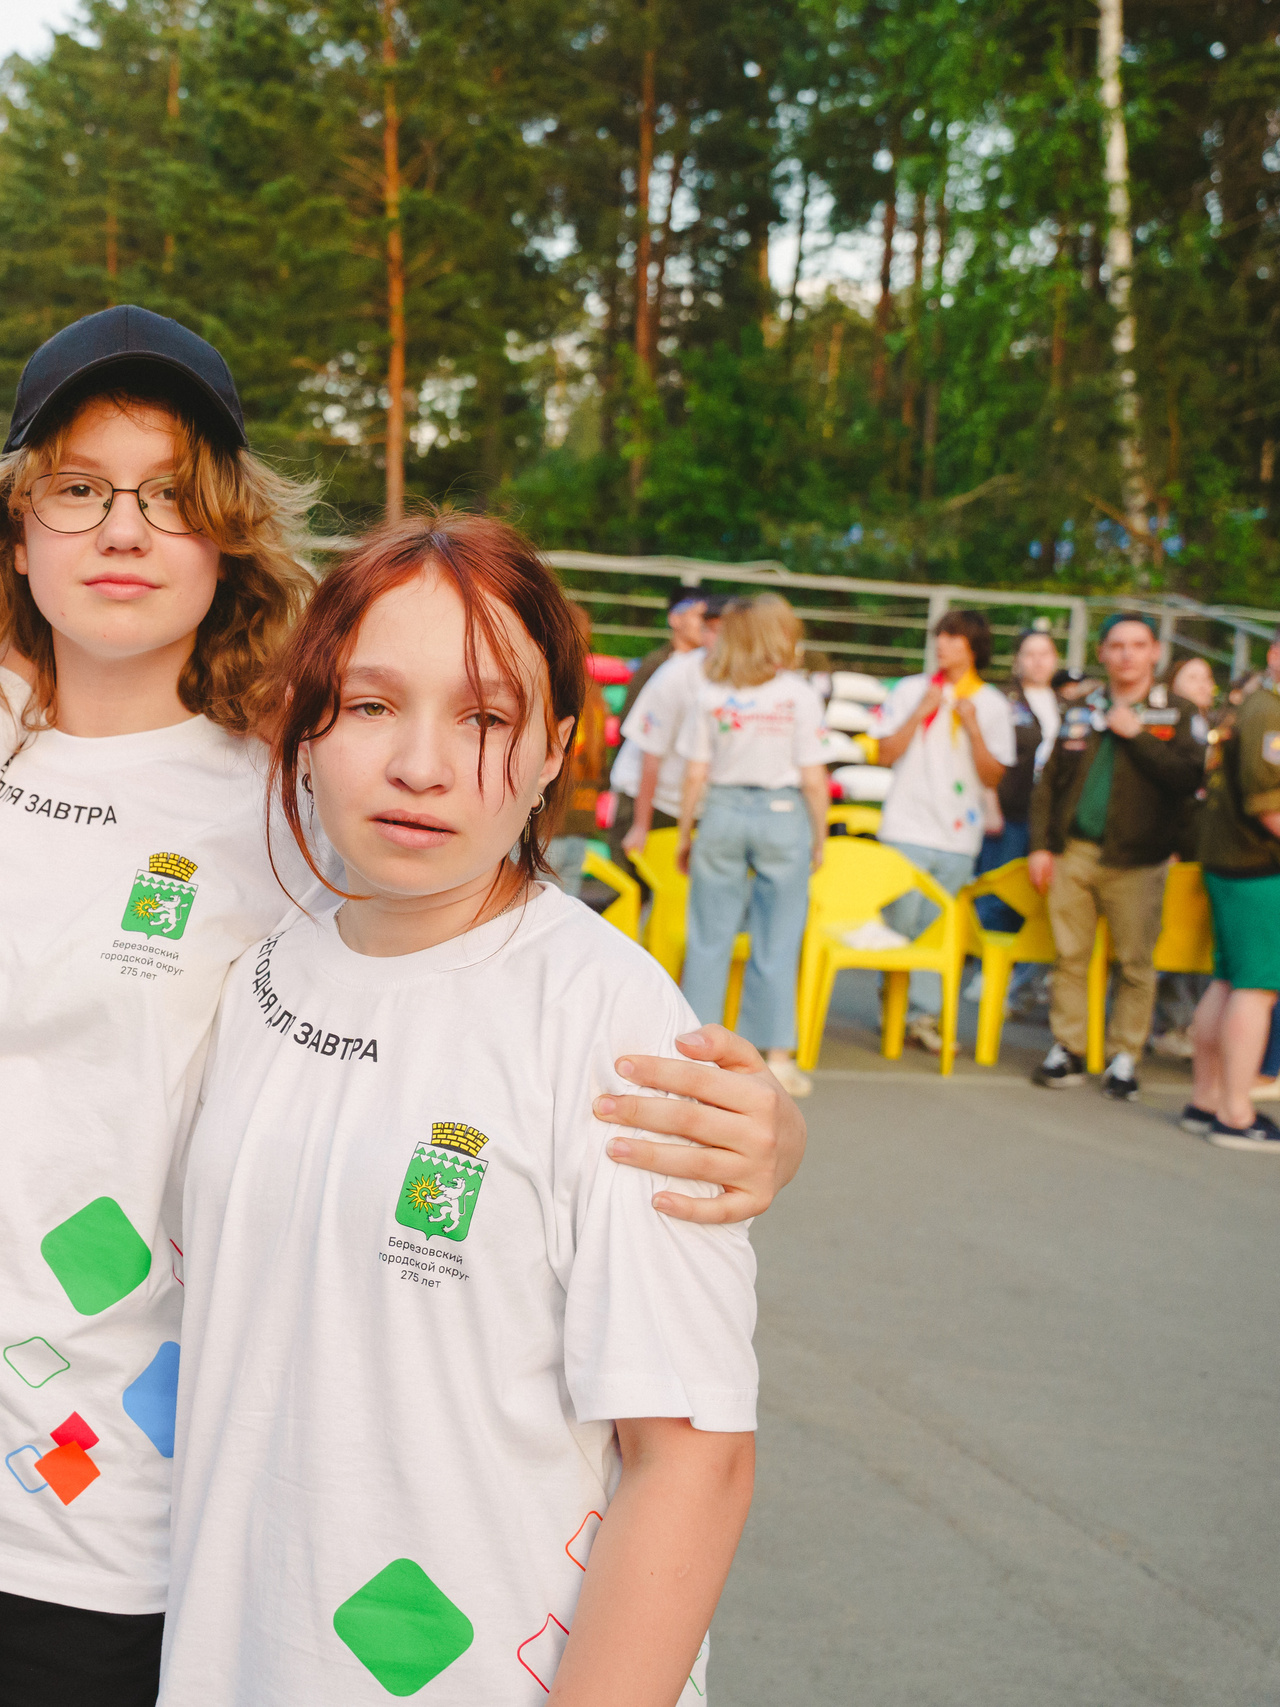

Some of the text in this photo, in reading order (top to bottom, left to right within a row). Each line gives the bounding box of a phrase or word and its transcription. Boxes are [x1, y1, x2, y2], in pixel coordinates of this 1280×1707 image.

[24, 793, 117, 825] ЗАВТРА
[112, 939, 179, 961] Березовский
[100, 952, 185, 976] городской округ
[120, 966, 157, 981] 275 лет
[252, 931, 286, 1014] ЕГОДНЯ
[293, 1022, 378, 1063] ЗАВТРА
[388, 1236, 463, 1265] Березовский
[378, 1252, 470, 1281] городской округ
[400, 1269, 441, 1289] 275 лет
